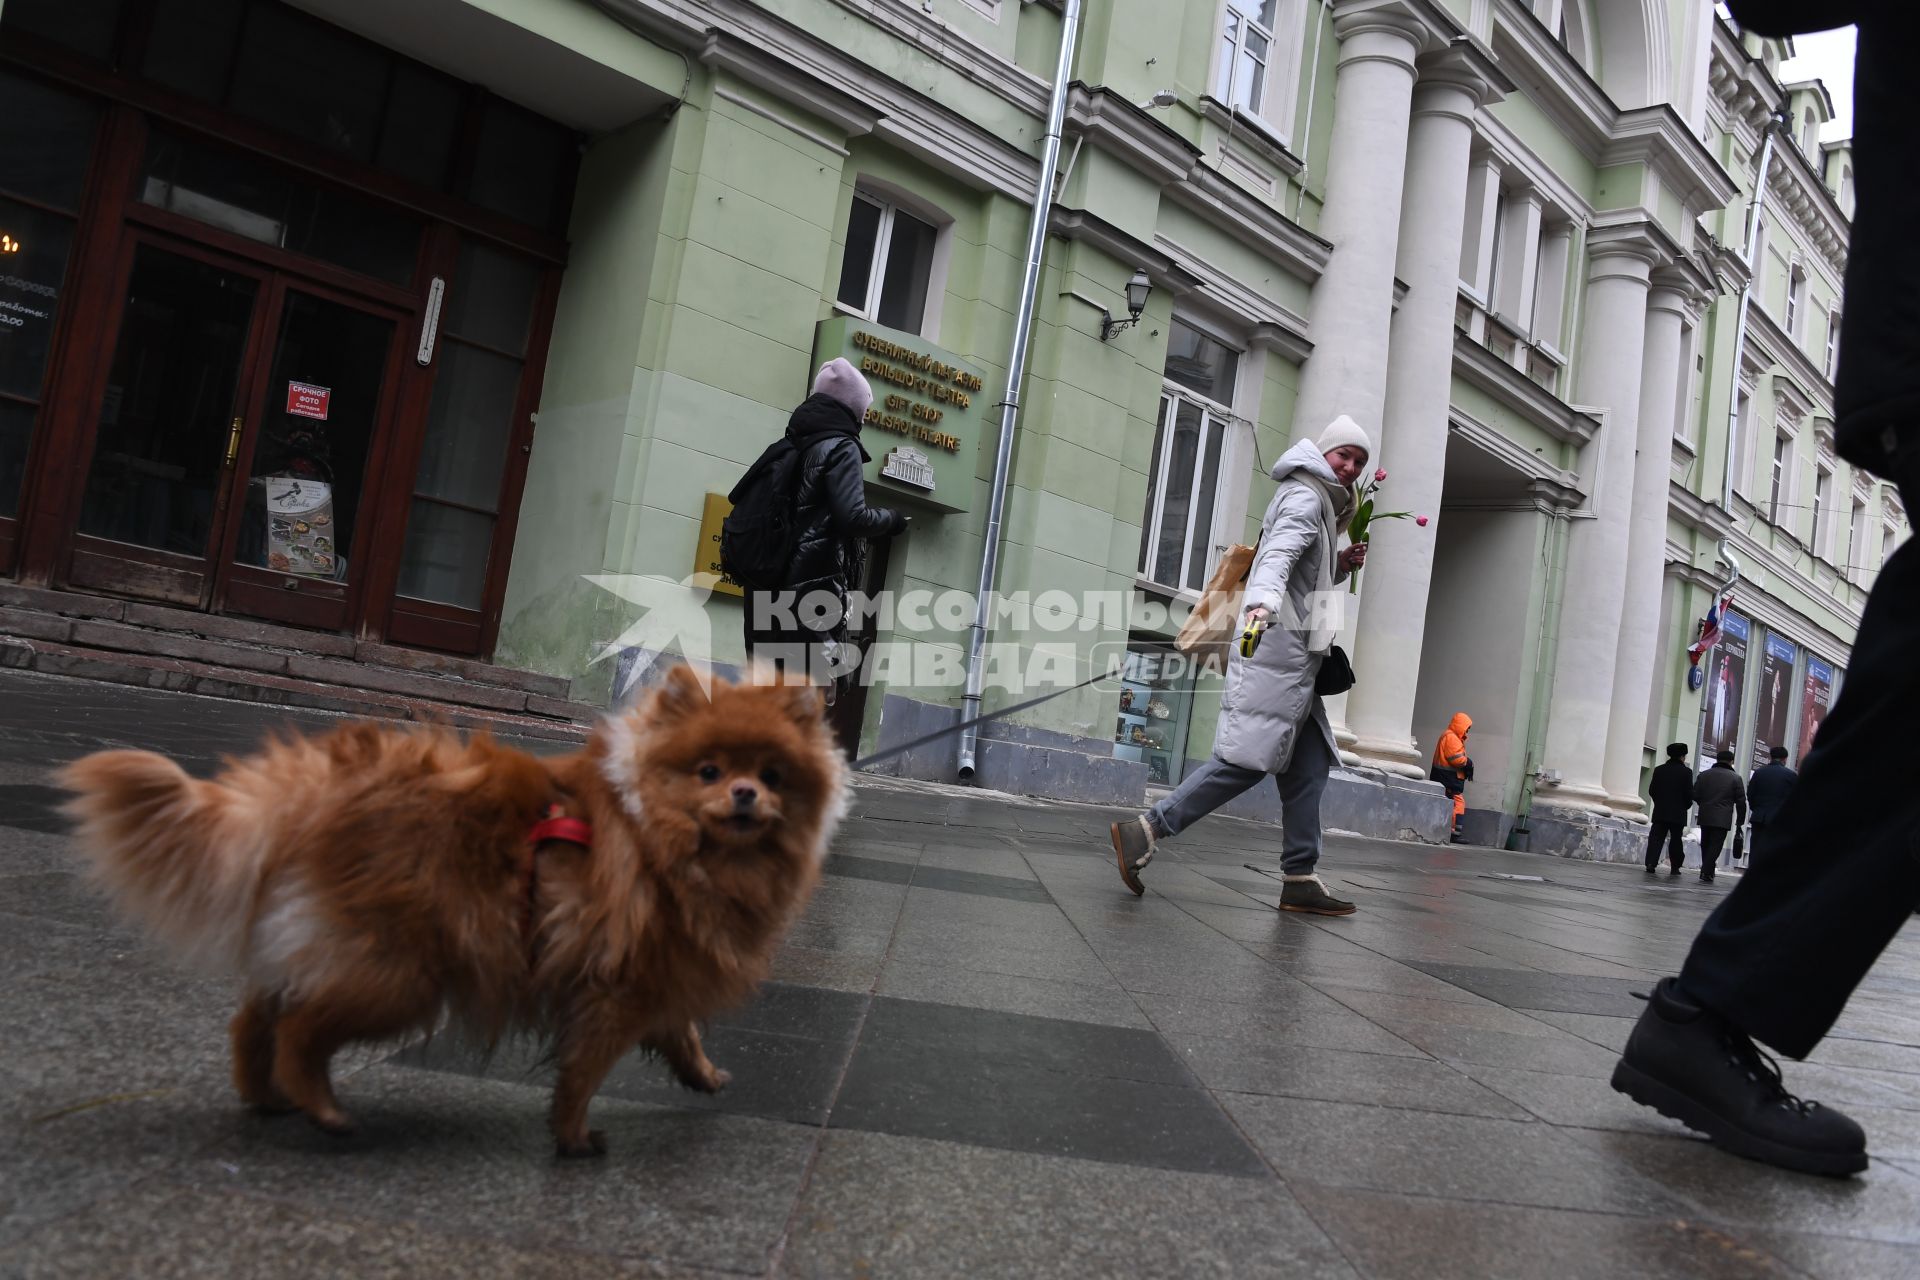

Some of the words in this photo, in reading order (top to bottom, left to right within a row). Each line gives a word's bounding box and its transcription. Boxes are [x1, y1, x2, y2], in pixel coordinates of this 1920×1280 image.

[853, 331, 932, 371] СУВЕНИРНЫЙ
[934, 361, 983, 391] МАГАЗИН
[293, 386, 326, 397] СРОЧНОЕ
[299, 396, 319, 405] ФОТО
[862, 356, 928, 391] БОЛЬШОГО
[929, 380, 970, 409] ТЕАТРА
[886, 394, 912, 412] GIFT
[913, 403, 944, 424] SHOP
[864, 408, 912, 434] BOLSHOI
[914, 424, 961, 451] THEATRE
